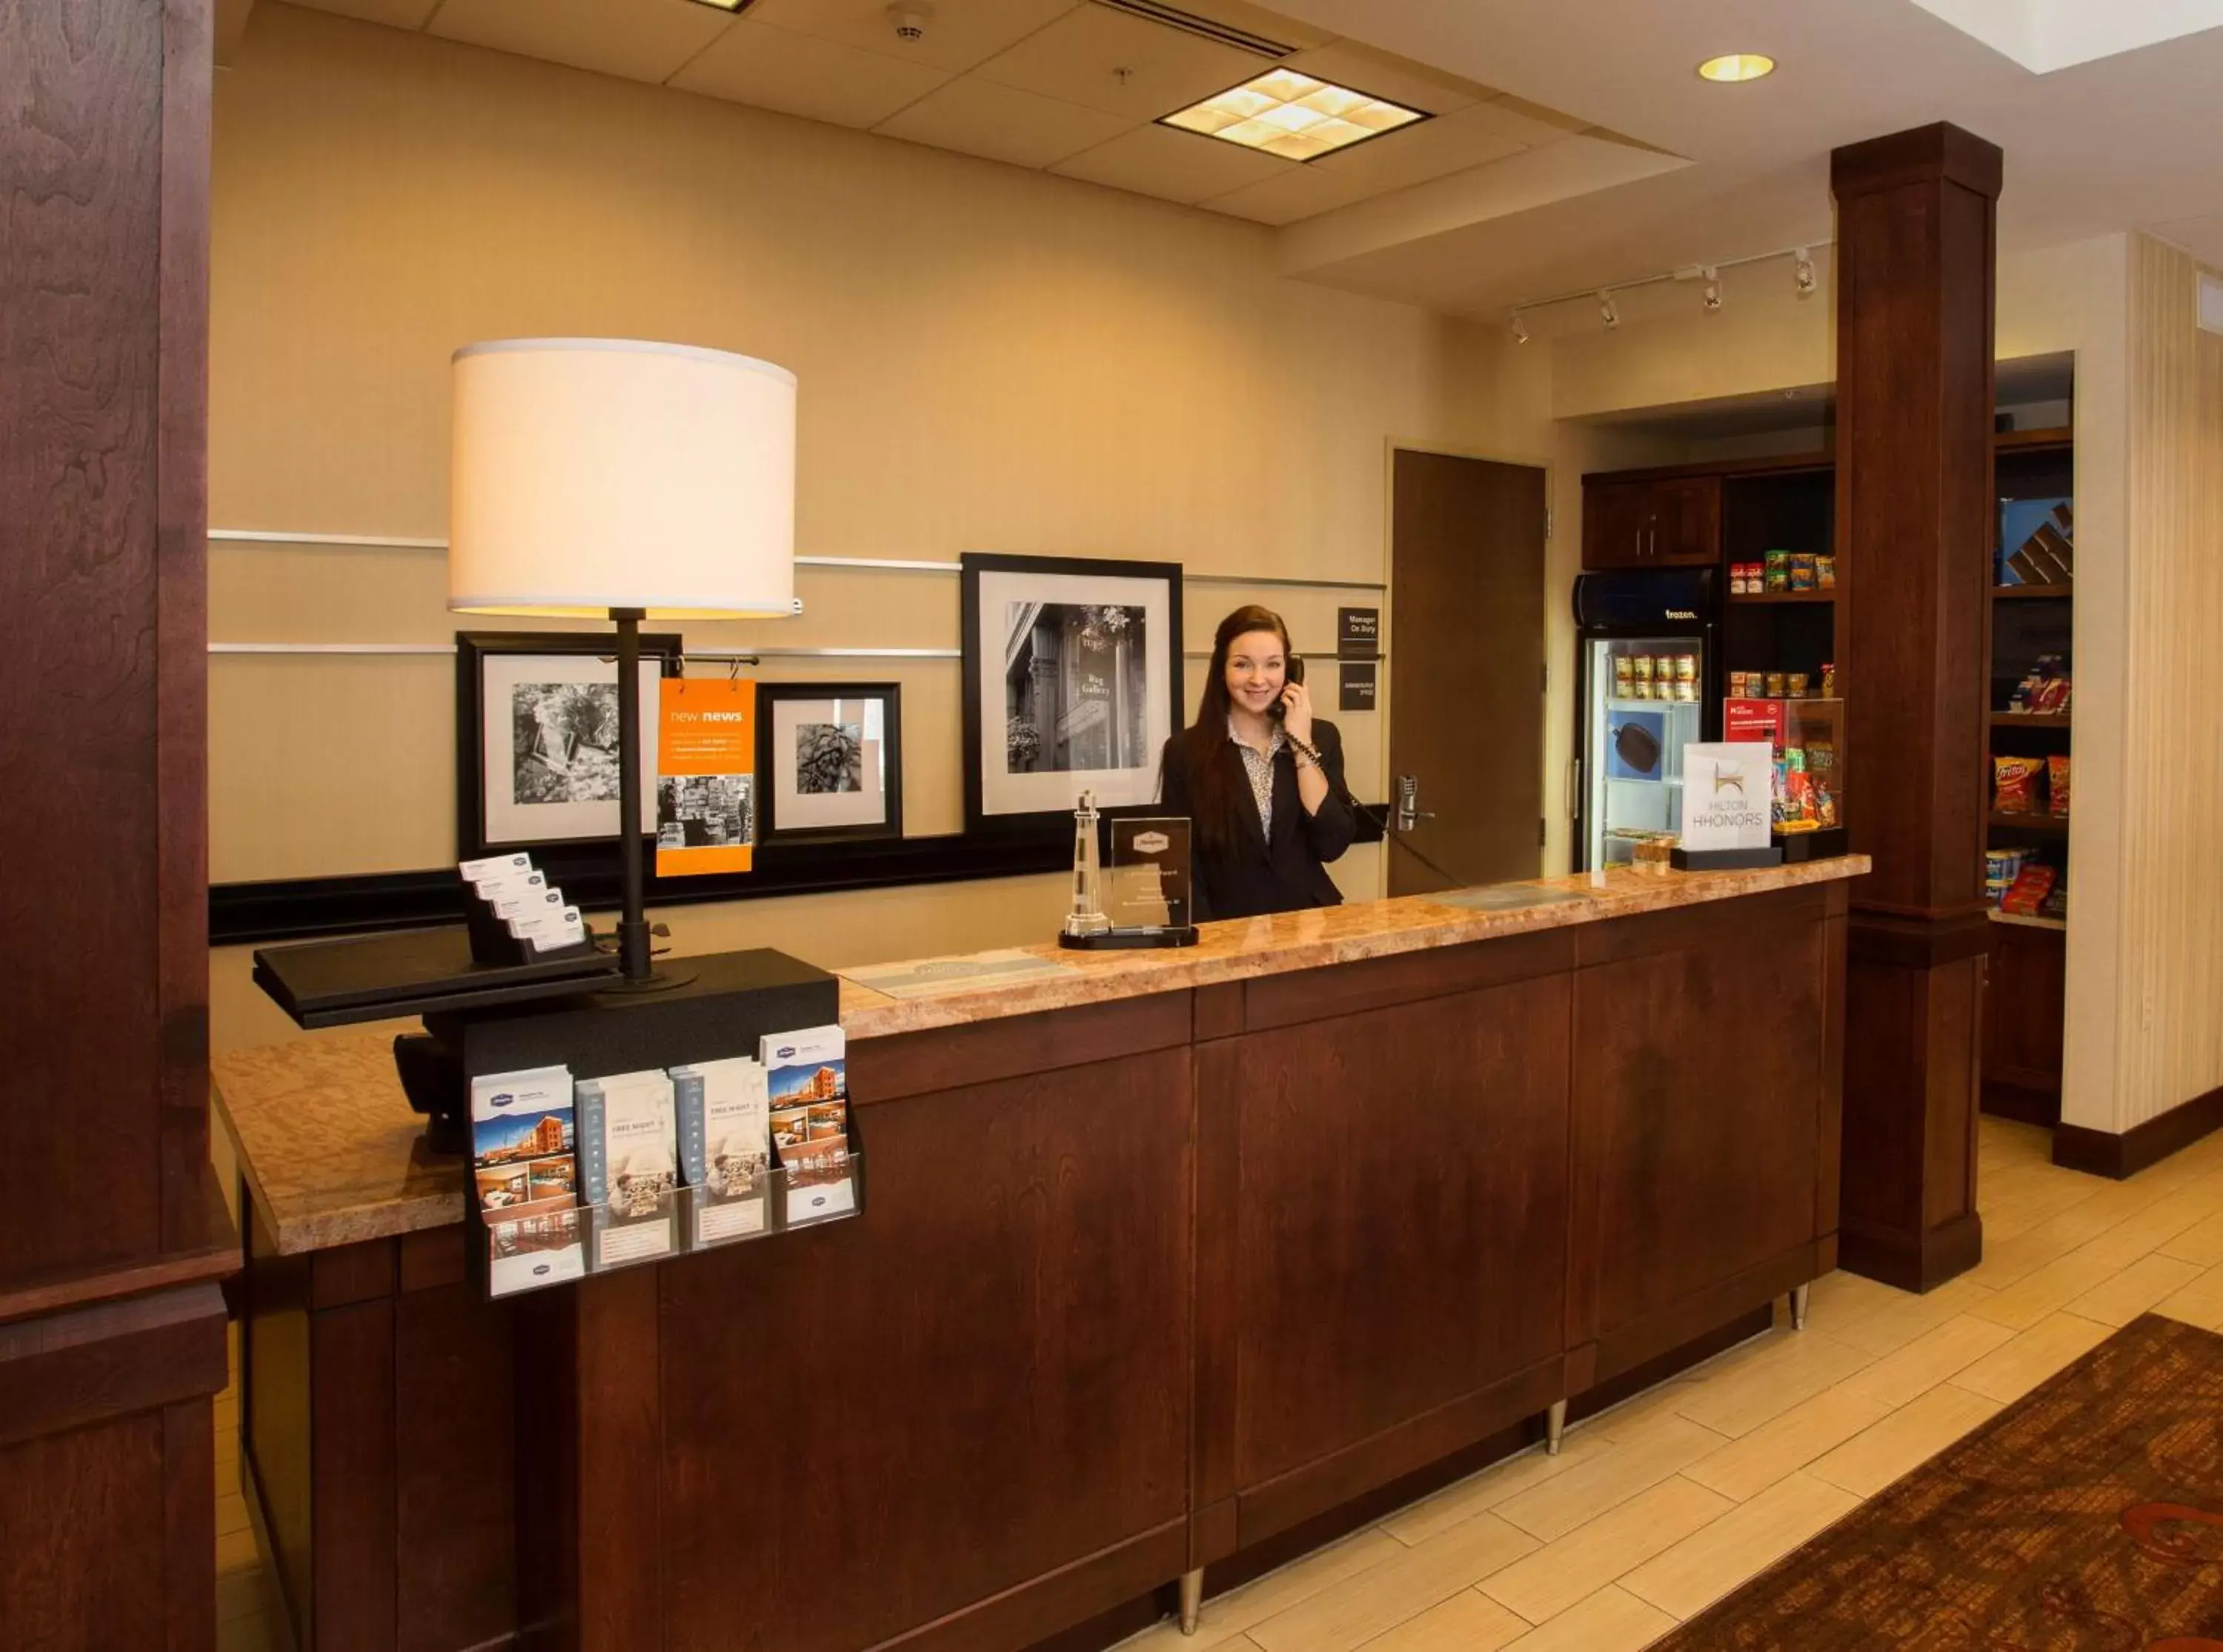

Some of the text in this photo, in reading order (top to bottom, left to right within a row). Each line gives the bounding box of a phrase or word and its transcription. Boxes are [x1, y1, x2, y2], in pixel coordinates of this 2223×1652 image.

[1349, 616, 1375, 626] Manager
[1082, 684, 1110, 697] Gallery
[670, 711, 742, 722] new news
[1709, 800, 1748, 811] HILTON
[1693, 812, 1764, 828] HHONORS
